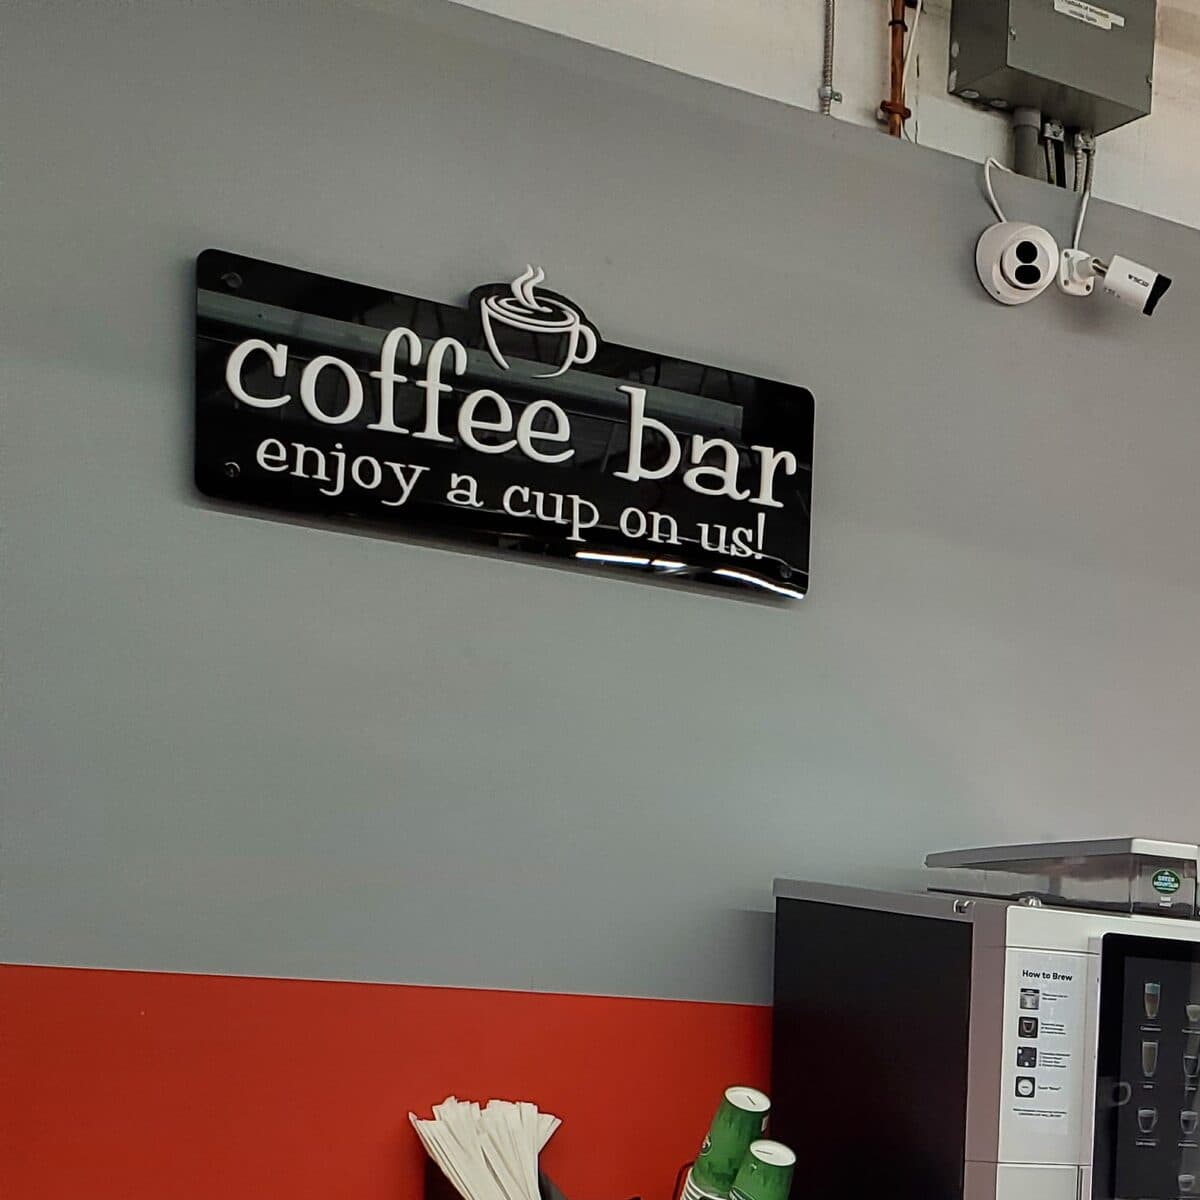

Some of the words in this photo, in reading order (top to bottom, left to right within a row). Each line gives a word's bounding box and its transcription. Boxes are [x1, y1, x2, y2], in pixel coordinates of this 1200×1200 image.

[225, 326, 575, 464] coffee
[615, 384, 797, 509] bar
[256, 437, 430, 506] enjoy
[447, 472, 484, 509] a
[502, 484, 600, 542] cup
[619, 506, 682, 546] on
[700, 512, 766, 560] us!
[1022, 968, 1041, 978] How
[1042, 972, 1051, 980] to
[1052, 972, 1073, 981] Brew
